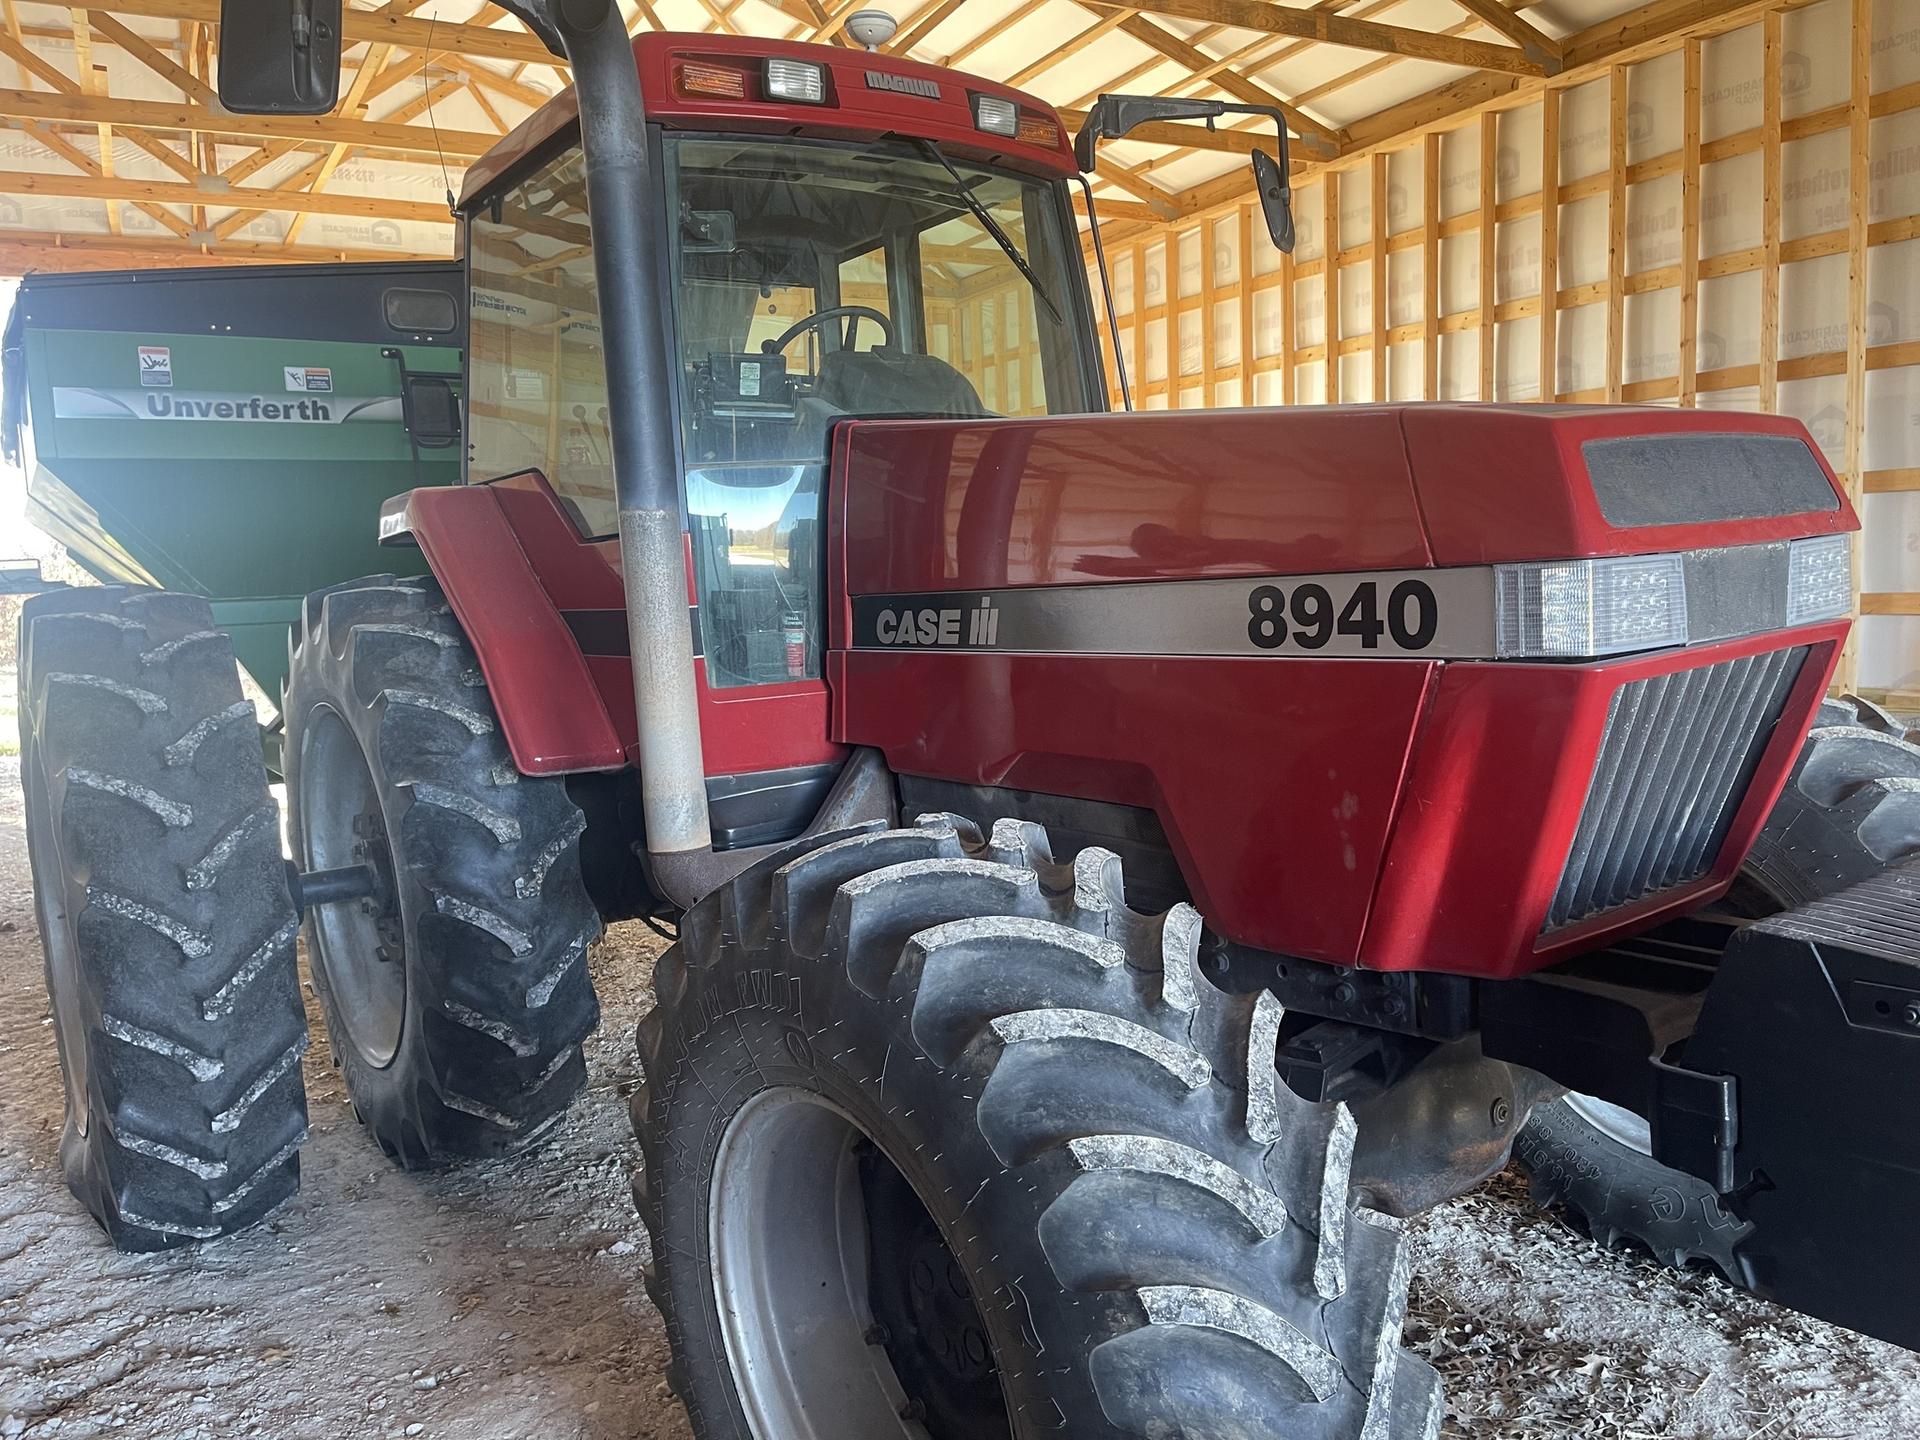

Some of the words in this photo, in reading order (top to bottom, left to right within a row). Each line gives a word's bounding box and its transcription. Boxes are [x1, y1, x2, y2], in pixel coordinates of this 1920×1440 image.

[147, 394, 330, 421] Unverferth
[876, 609, 960, 645] CASE
[1247, 581, 1438, 649] 8940
